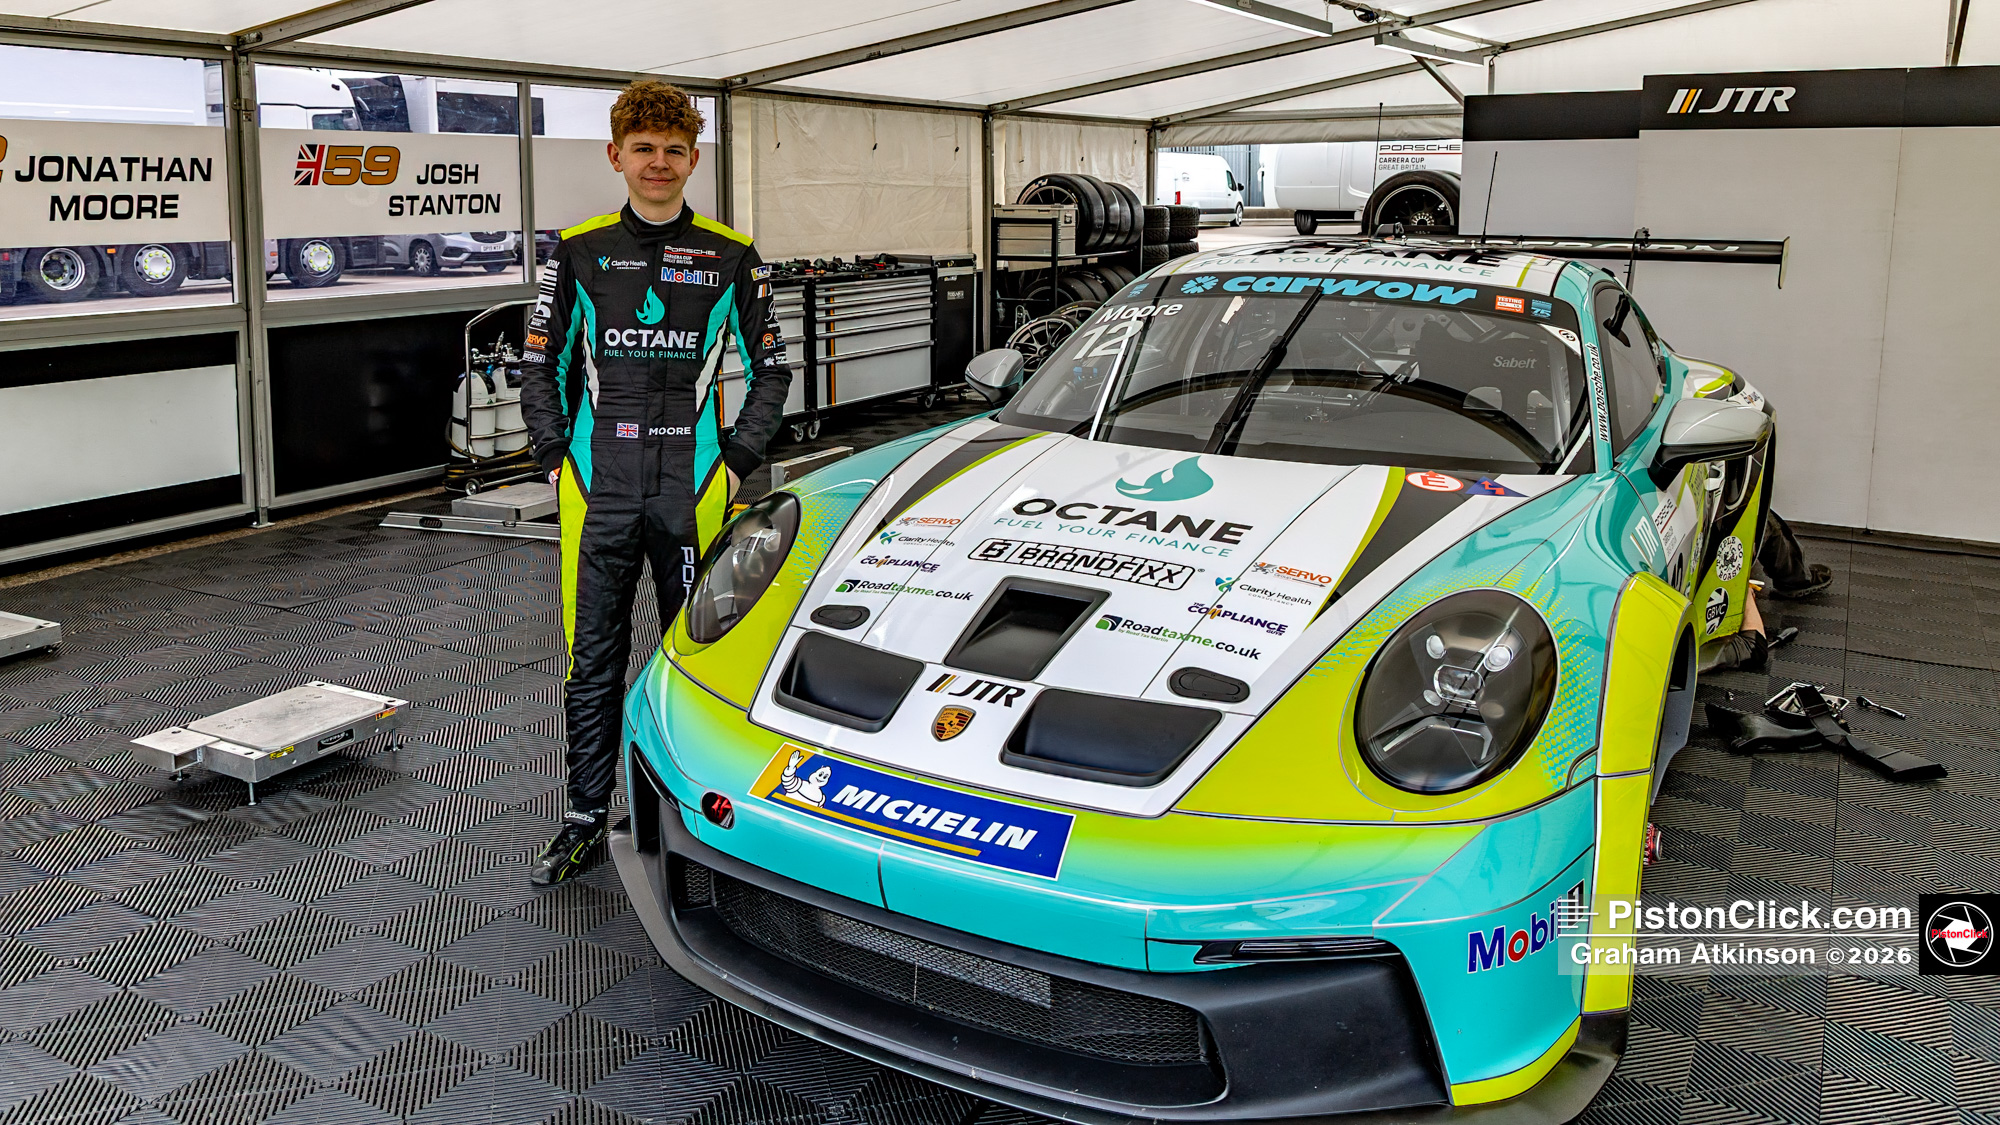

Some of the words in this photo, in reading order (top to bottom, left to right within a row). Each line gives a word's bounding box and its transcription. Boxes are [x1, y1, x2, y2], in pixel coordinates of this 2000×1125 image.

[1698, 86, 1796, 113] JTR
[1379, 144, 1461, 152] PORSCHE
[15, 155, 212, 182] JONATHAN
[322, 145, 401, 186] 59
[416, 163, 479, 185] JOSH
[49, 193, 179, 221] MOORE
[388, 193, 501, 217] STANTON
[664, 245, 716, 256] PORSCHE
[611, 260, 630, 268] Clarity
[1200, 257, 1260, 267] FUEL
[1278, 256, 1348, 264] YOUR
[1363, 258, 1496, 278] FINANCE
[661, 266, 703, 285] Mobil
[1222, 275, 1477, 305] carwow
[1094, 303, 1184, 325] Moore
[604, 328, 700, 349] OCTANE
[1072, 320, 1145, 361] 12
[604, 349, 624, 357] FUEL
[627, 350, 655, 358] YOUR
[658, 350, 697, 360] FINANCE
[1492, 356, 1538, 369] Sabelt
[1586, 342, 1609, 442] www.porsche.co.uk
[648, 426, 692, 436] MOORE
[917, 517, 961, 525] SERVO
[1012, 498, 1254, 545] OCTANE
[993, 517, 1043, 530] FUEL
[1057, 522, 1116, 539] YOUR
[1125, 532, 1233, 558] FINANCE
[1017, 546, 1182, 584] BRANDFIXX
[1276, 565, 1333, 584] SERVO
[857, 580, 974, 601] Roadtaxme.co.uk
[1239, 583, 1276, 597] Clarity
[1276, 592, 1312, 606] Health
[1248, 593, 1294, 607] CONSULTANCY
[1706, 602, 1725, 621] GBVC
[1121, 618, 1262, 661] Roadtaxme.co.uk
[947, 679, 1026, 708] JTR
[831, 784, 1038, 851] MICHELIN
[1467, 896, 1562, 974] Mobil
